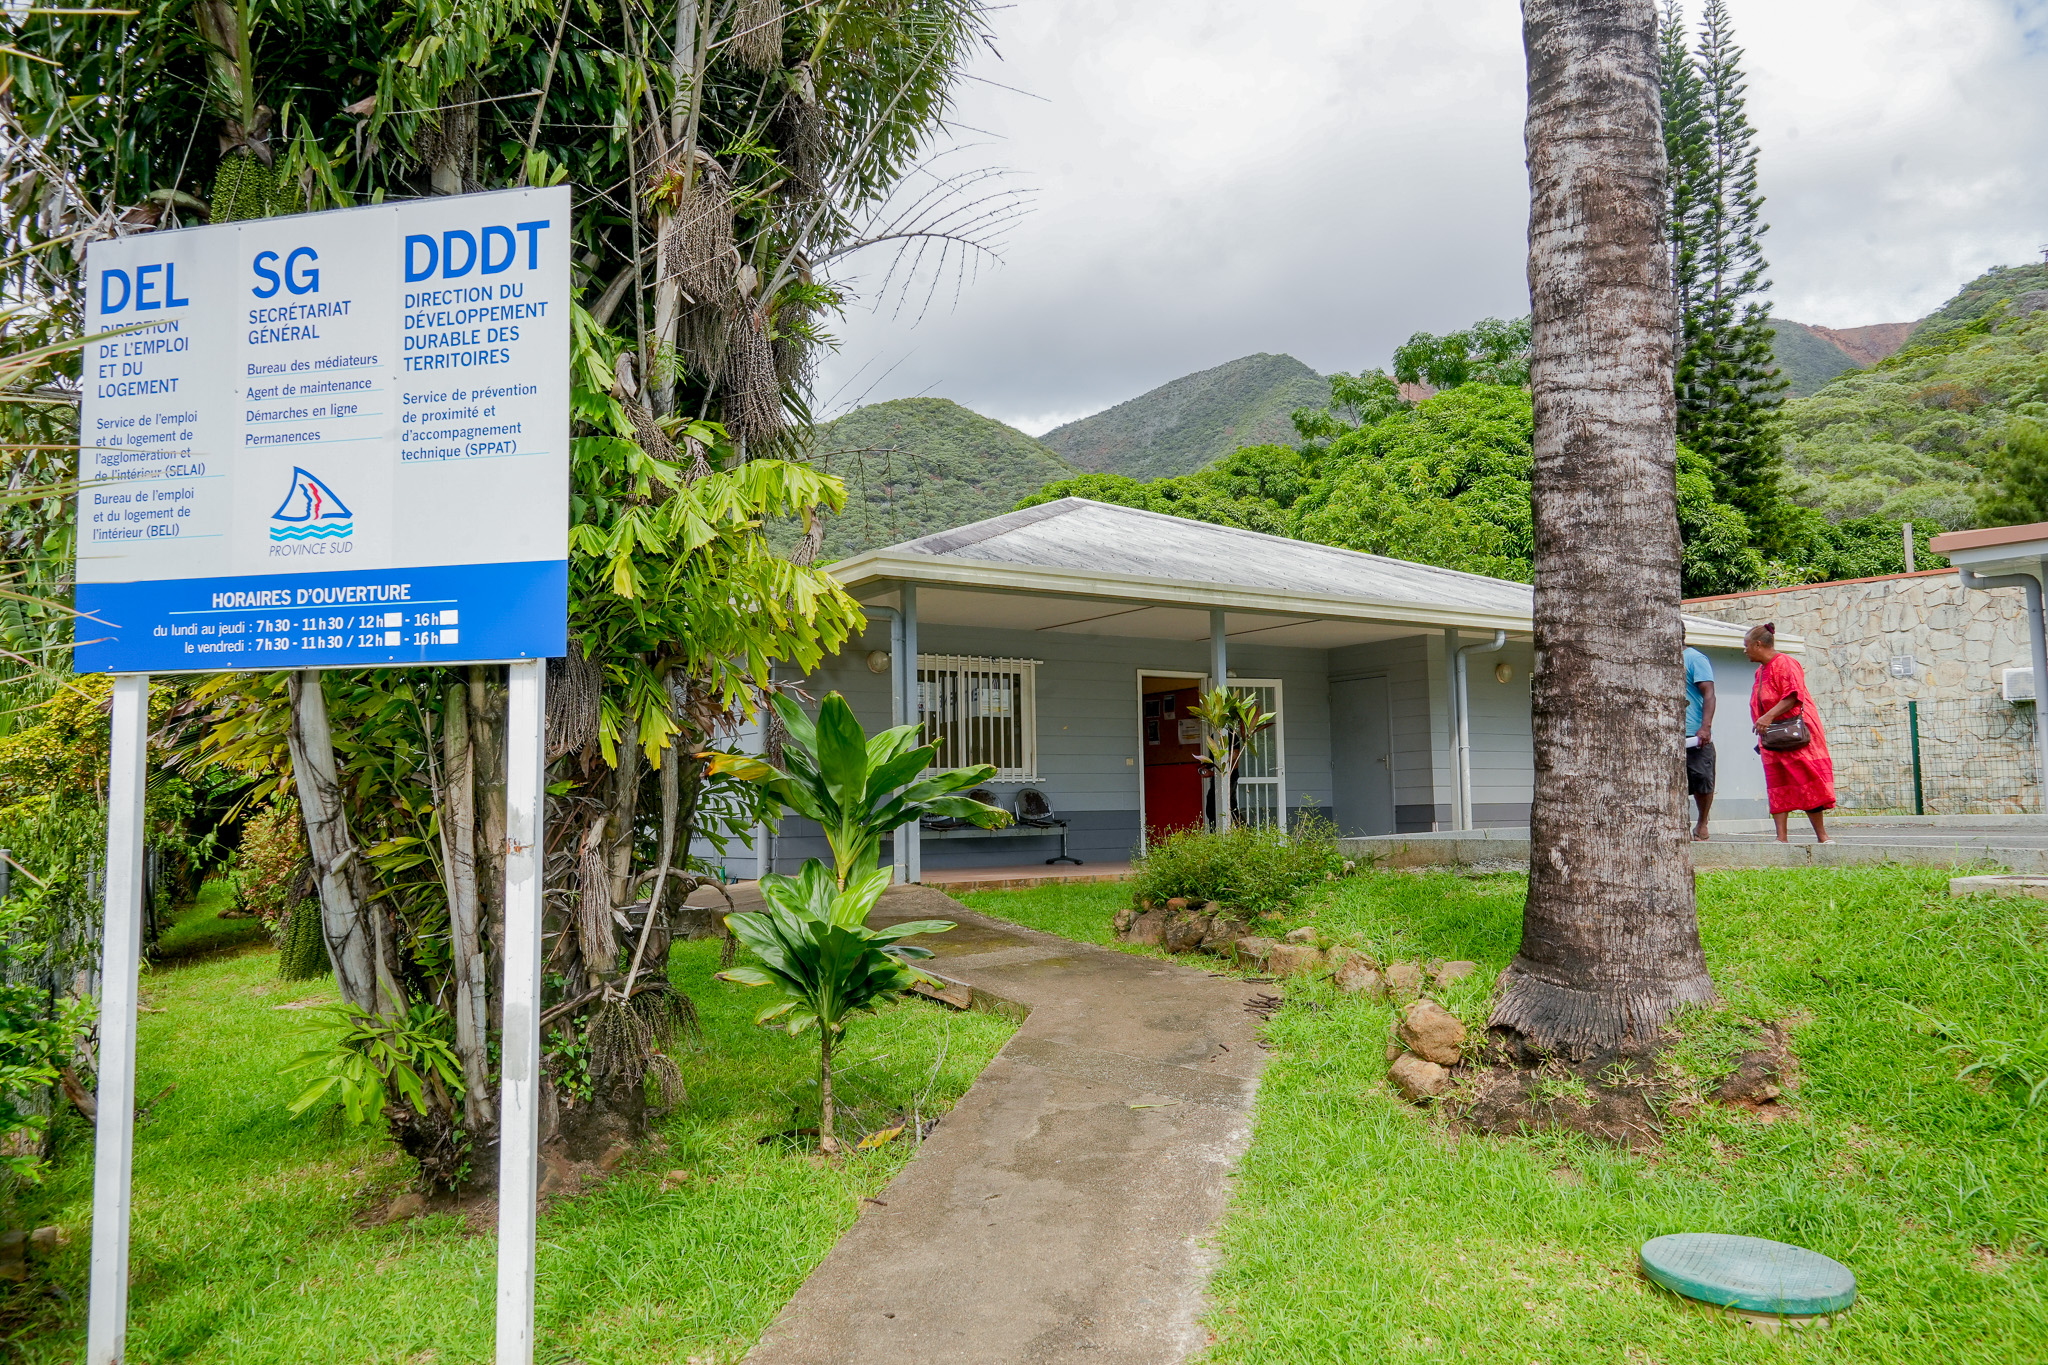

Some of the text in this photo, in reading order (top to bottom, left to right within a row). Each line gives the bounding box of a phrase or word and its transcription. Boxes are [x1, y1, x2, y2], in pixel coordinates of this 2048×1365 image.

[405, 219, 550, 283] DDDT
[251, 246, 319, 299] SG
[100, 262, 189, 315] DEL
[405, 282, 523, 309] DIRECTION DU
[249, 300, 351, 324] SECRÉTARIAT
[405, 301, 548, 330] DÉVELOPPEMENT
[248, 323, 320, 345] GÉNÉRAL
[404, 325, 519, 351] DURABLE DES
[100, 337, 189, 359] DE L'EMPLOI
[99, 361, 143, 379] ET DU
[247, 355, 378, 375] Bureau des médiateurs
[403, 348, 510, 372] TERRITOIRES
[98, 378, 179, 399] LOGEMENT
[246, 378, 372, 401] Agent de maintenance
[403, 383, 537, 405] Service de prévention
[96, 410, 198, 430] Service de l'emploi
[246, 403, 358, 422] Démarches en ligne
[402, 405, 496, 425] de proximité et
[96, 429, 193, 447] et du logement de
[245, 431, 321, 446] Permanences
[402, 422, 522, 442] d'accompagnement
[180, 447, 191, 459] et
[402, 439, 517, 461] technique (SPPAT)
[95, 470, 108, 482] de
[165, 462, 206, 478] (SELAI)
[94, 487, 195, 505] Bureau de l'emploi
[93, 505, 191, 523] et du logement de
[93, 523, 180, 540] l'intérieur (BELI)
[269, 541, 353, 557] PROVINCE SUD
[212, 584, 411, 608] HORAIRES D'OUVERTURE
[153, 624, 168, 637] du
[171, 623, 198, 636] lundi
[201, 625, 215, 635] au
[218, 621, 245, 637] jeudi
[347, 616, 355, 629] /
[184, 641, 195, 654] le
[197, 640, 244, 653] vendredi
[346, 635, 354, 648] /
